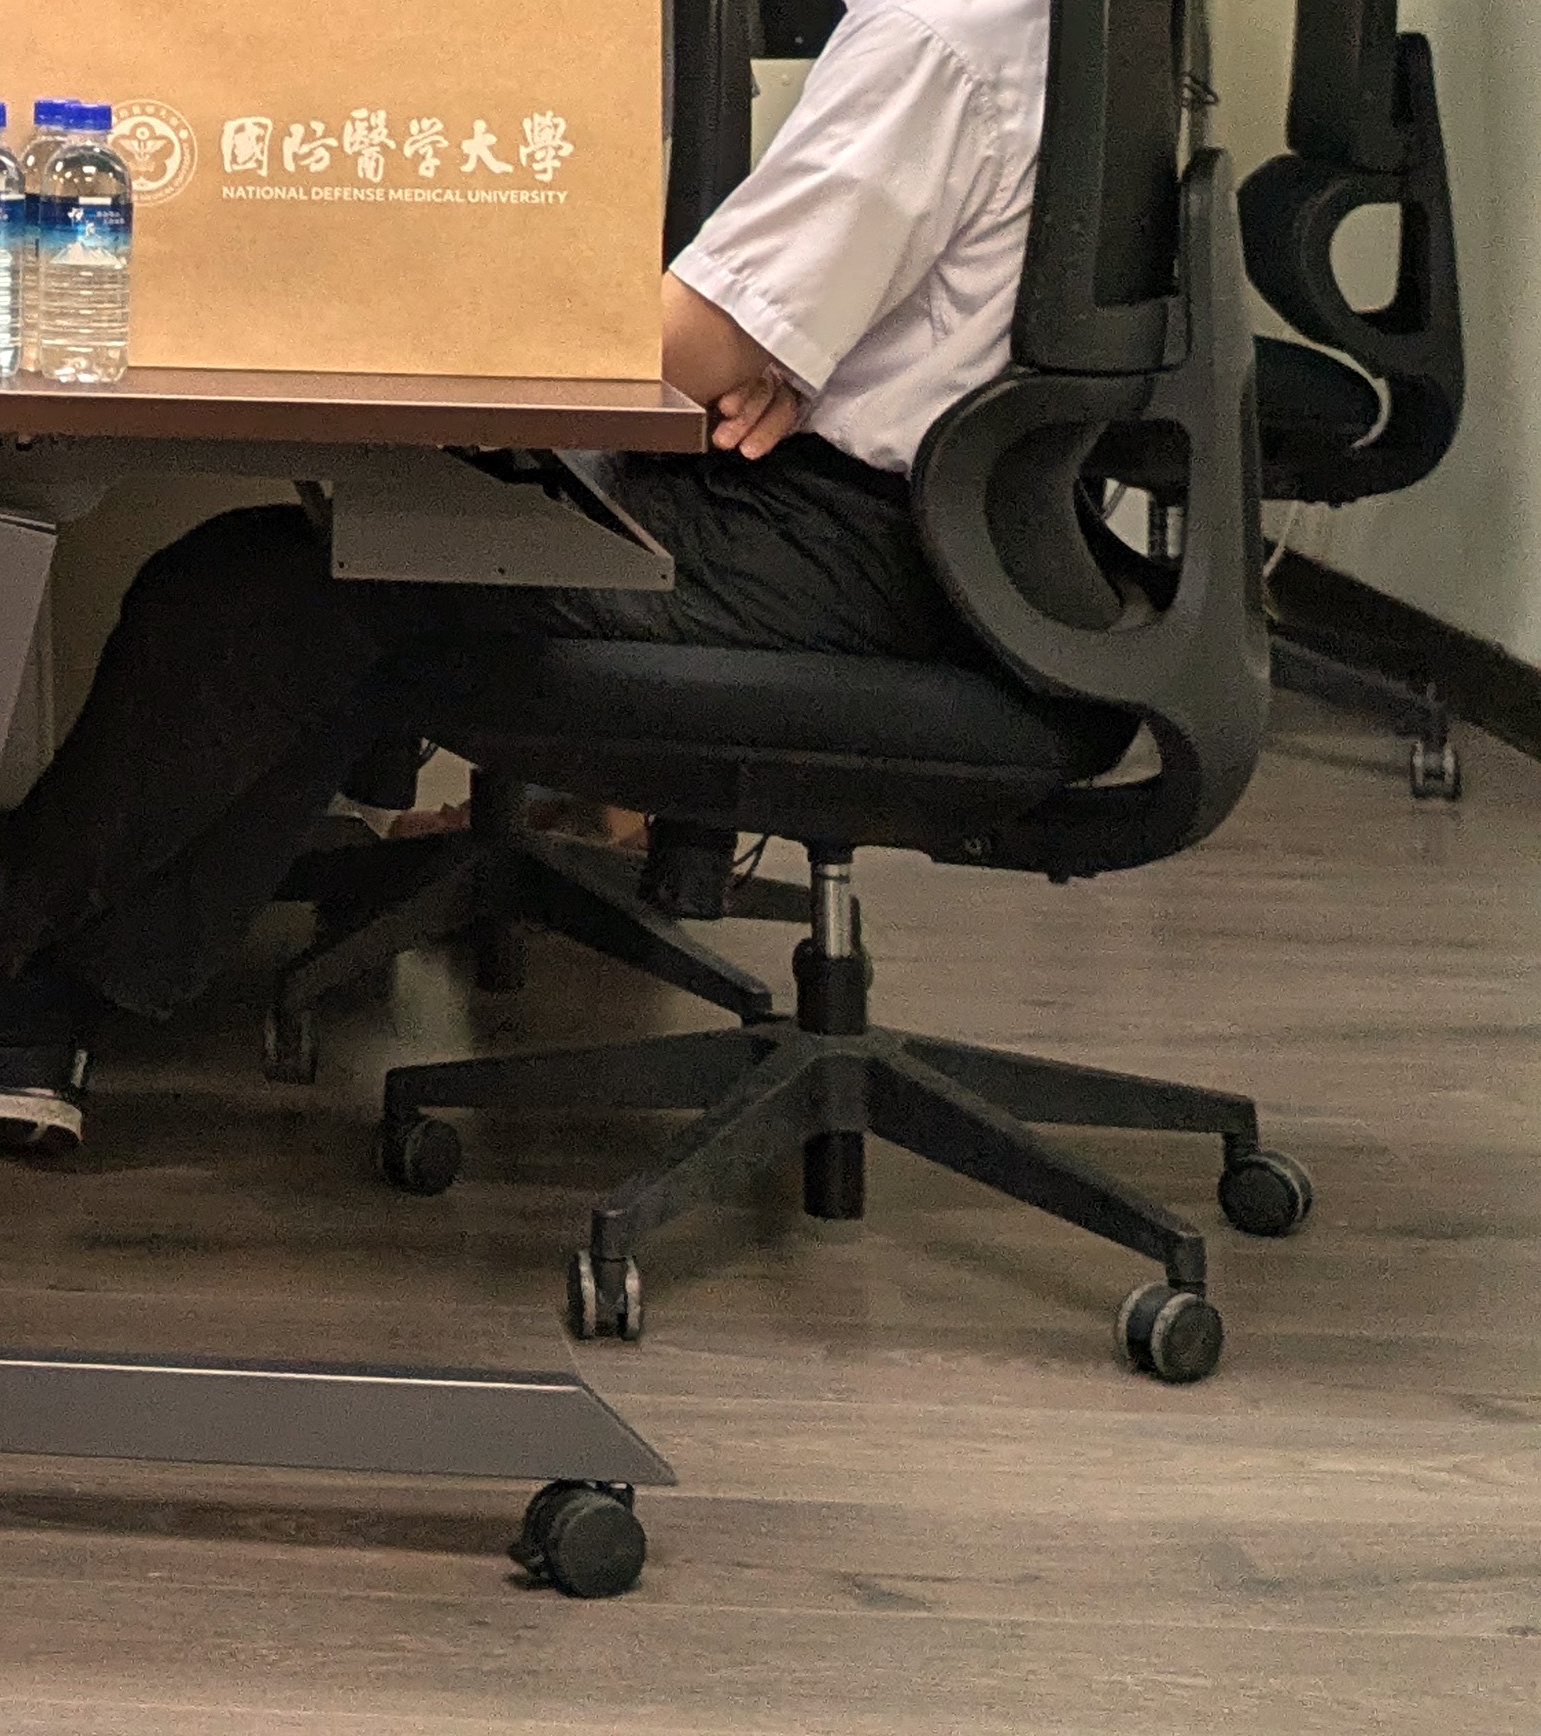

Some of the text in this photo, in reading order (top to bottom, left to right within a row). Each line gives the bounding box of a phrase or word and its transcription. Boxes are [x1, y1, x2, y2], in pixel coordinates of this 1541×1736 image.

[221, 185, 570, 205] NATIONAL DEFENSE MEDICAL UNIVERSITY
